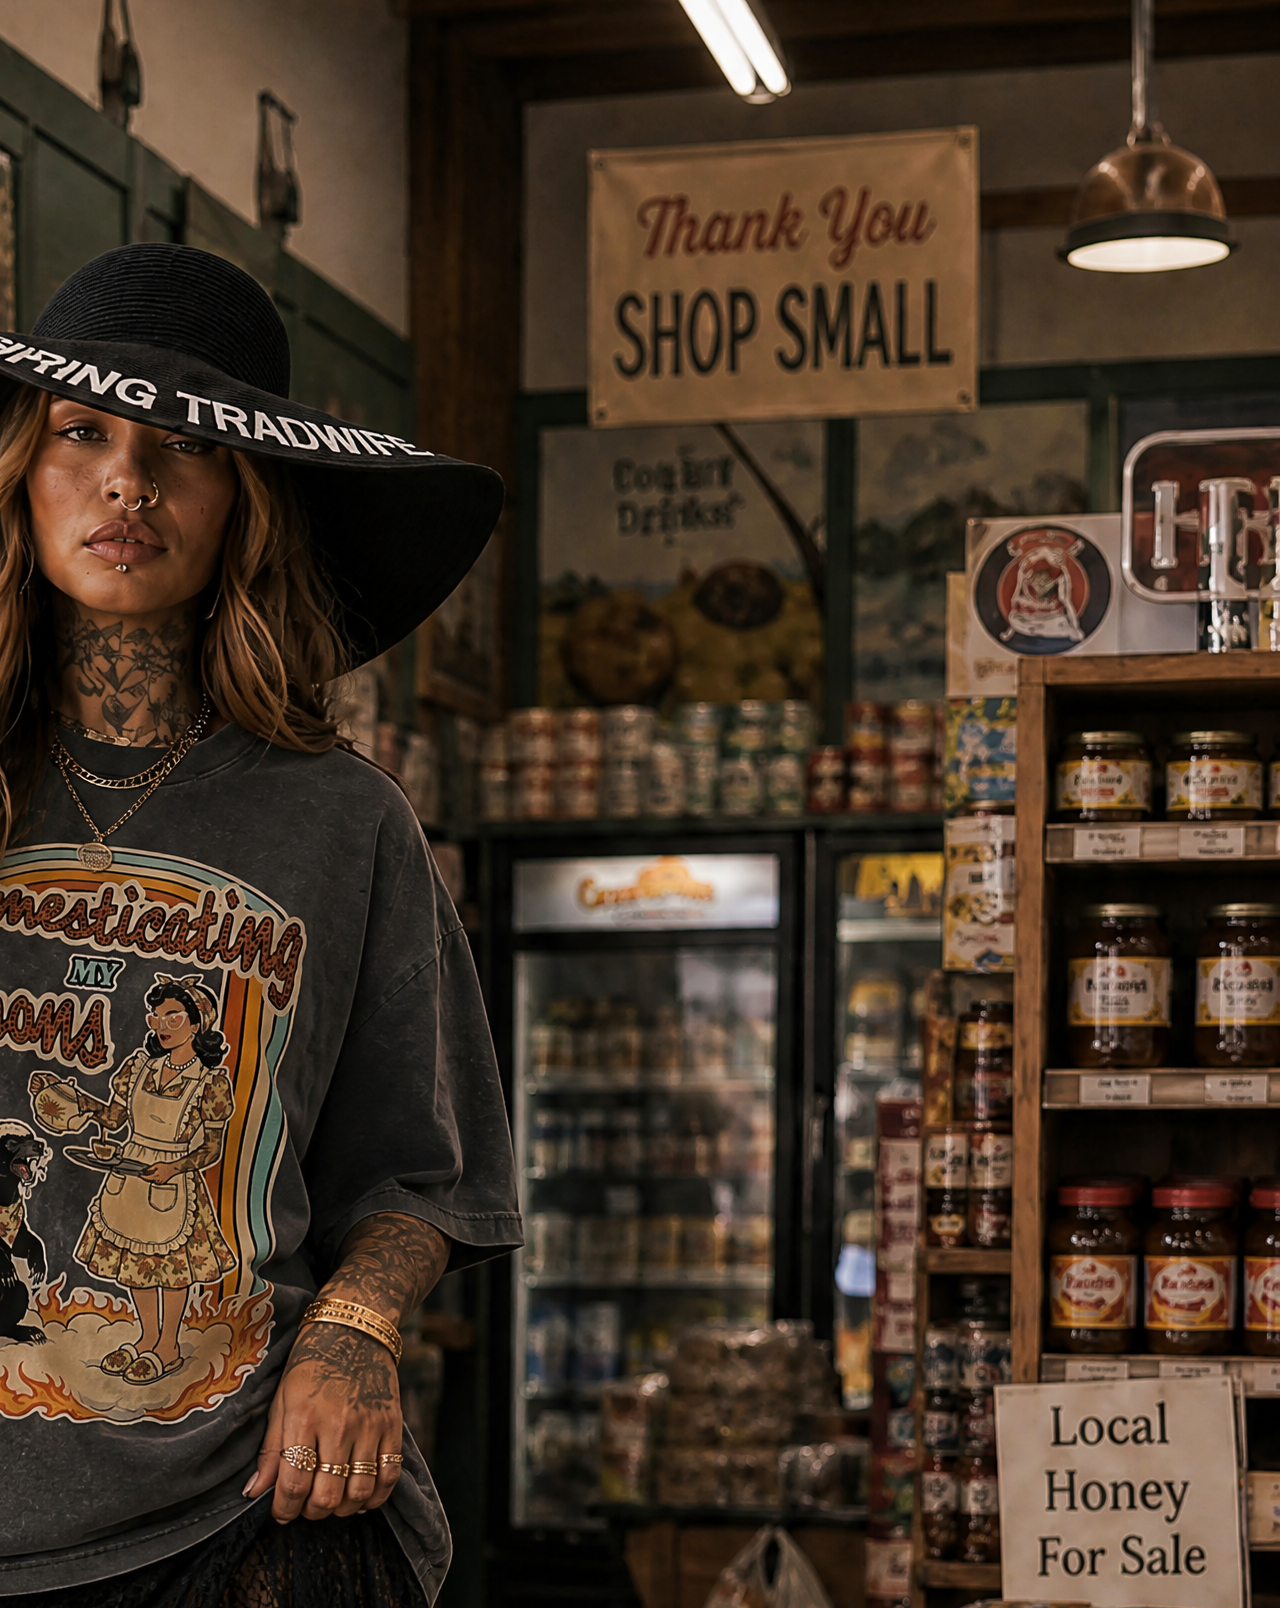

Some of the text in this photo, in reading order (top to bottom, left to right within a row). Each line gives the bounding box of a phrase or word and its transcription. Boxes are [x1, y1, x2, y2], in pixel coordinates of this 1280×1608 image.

[637, 186, 937, 270] Thank You
[614, 280, 952, 380] SHOP SMALL
[176, 390, 435, 457] TRADWIFE
[69, 957, 121, 988] MY
[1050, 1402, 1170, 1447] Local
[1044, 1469, 1190, 1523] Honey
[1037, 1533, 1207, 1578] For Sale
